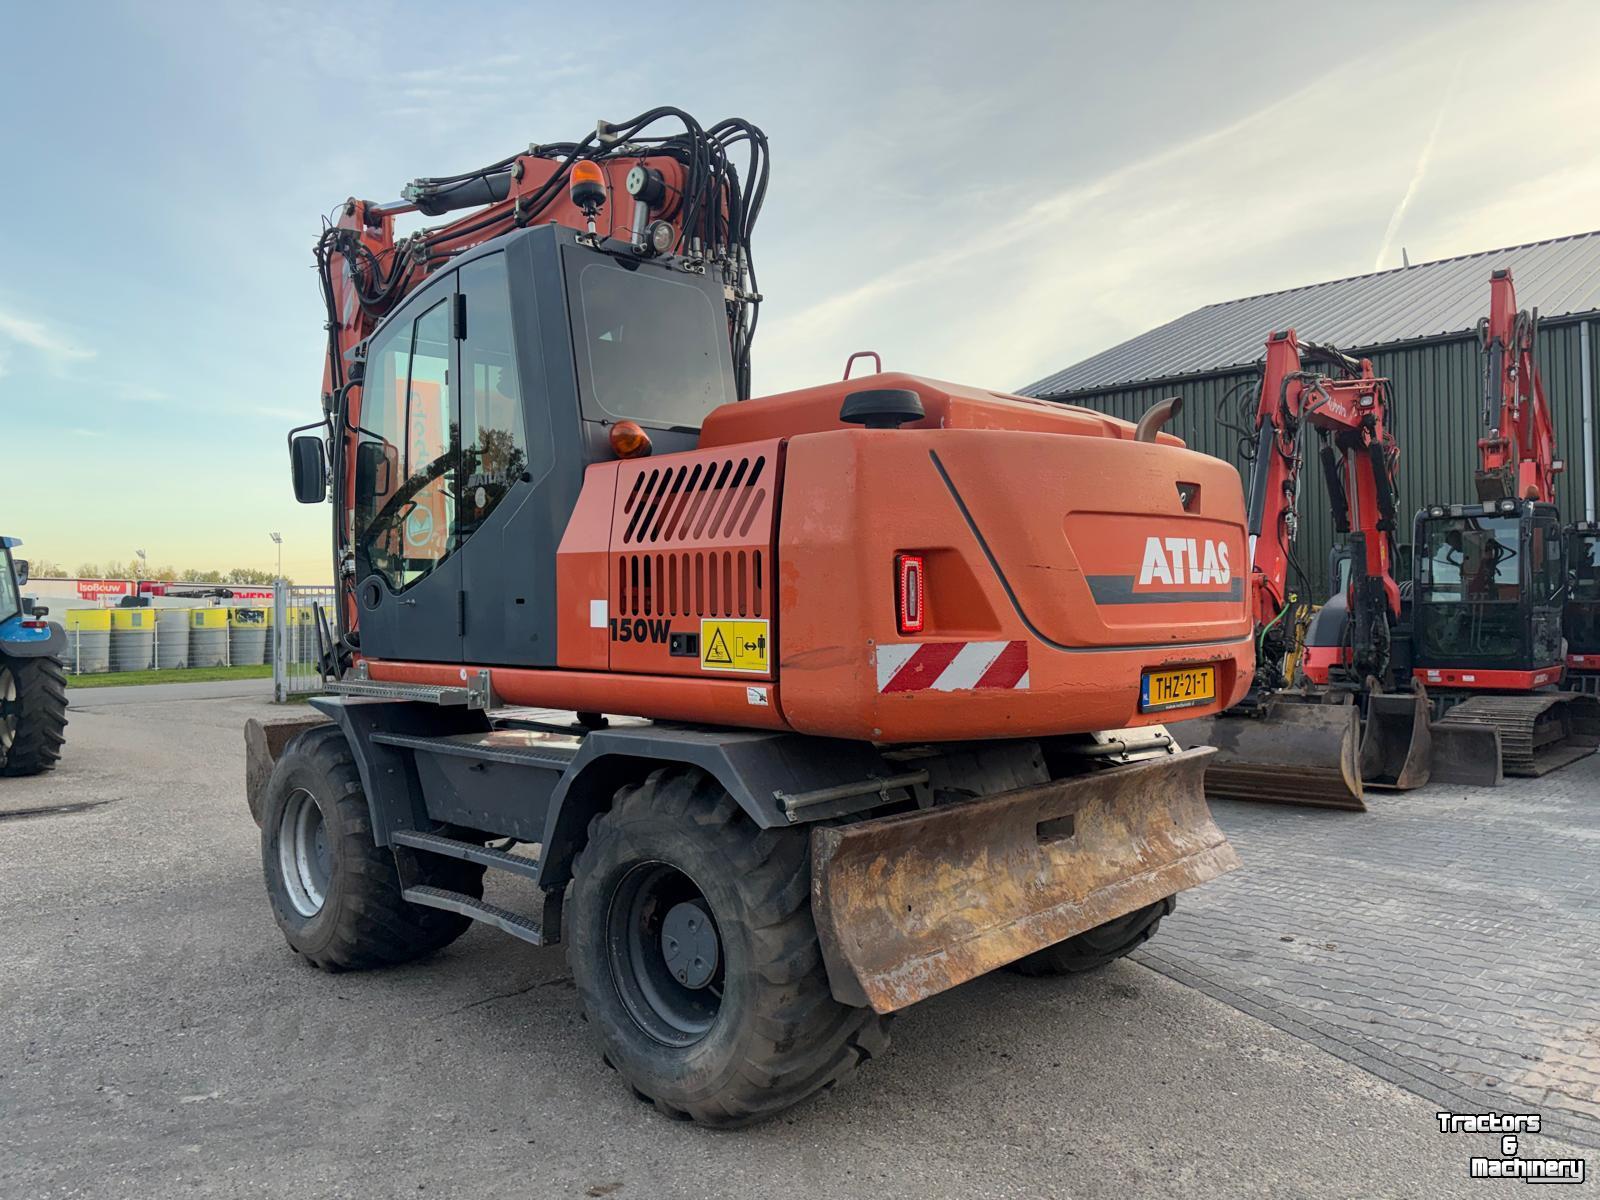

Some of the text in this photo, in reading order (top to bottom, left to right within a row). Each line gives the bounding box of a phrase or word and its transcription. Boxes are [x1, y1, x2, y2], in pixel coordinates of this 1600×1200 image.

[1139, 537, 1231, 585] ATLAS
[610, 618, 671, 643] 150W
[1156, 672, 1208, 700] THZ-21-T
